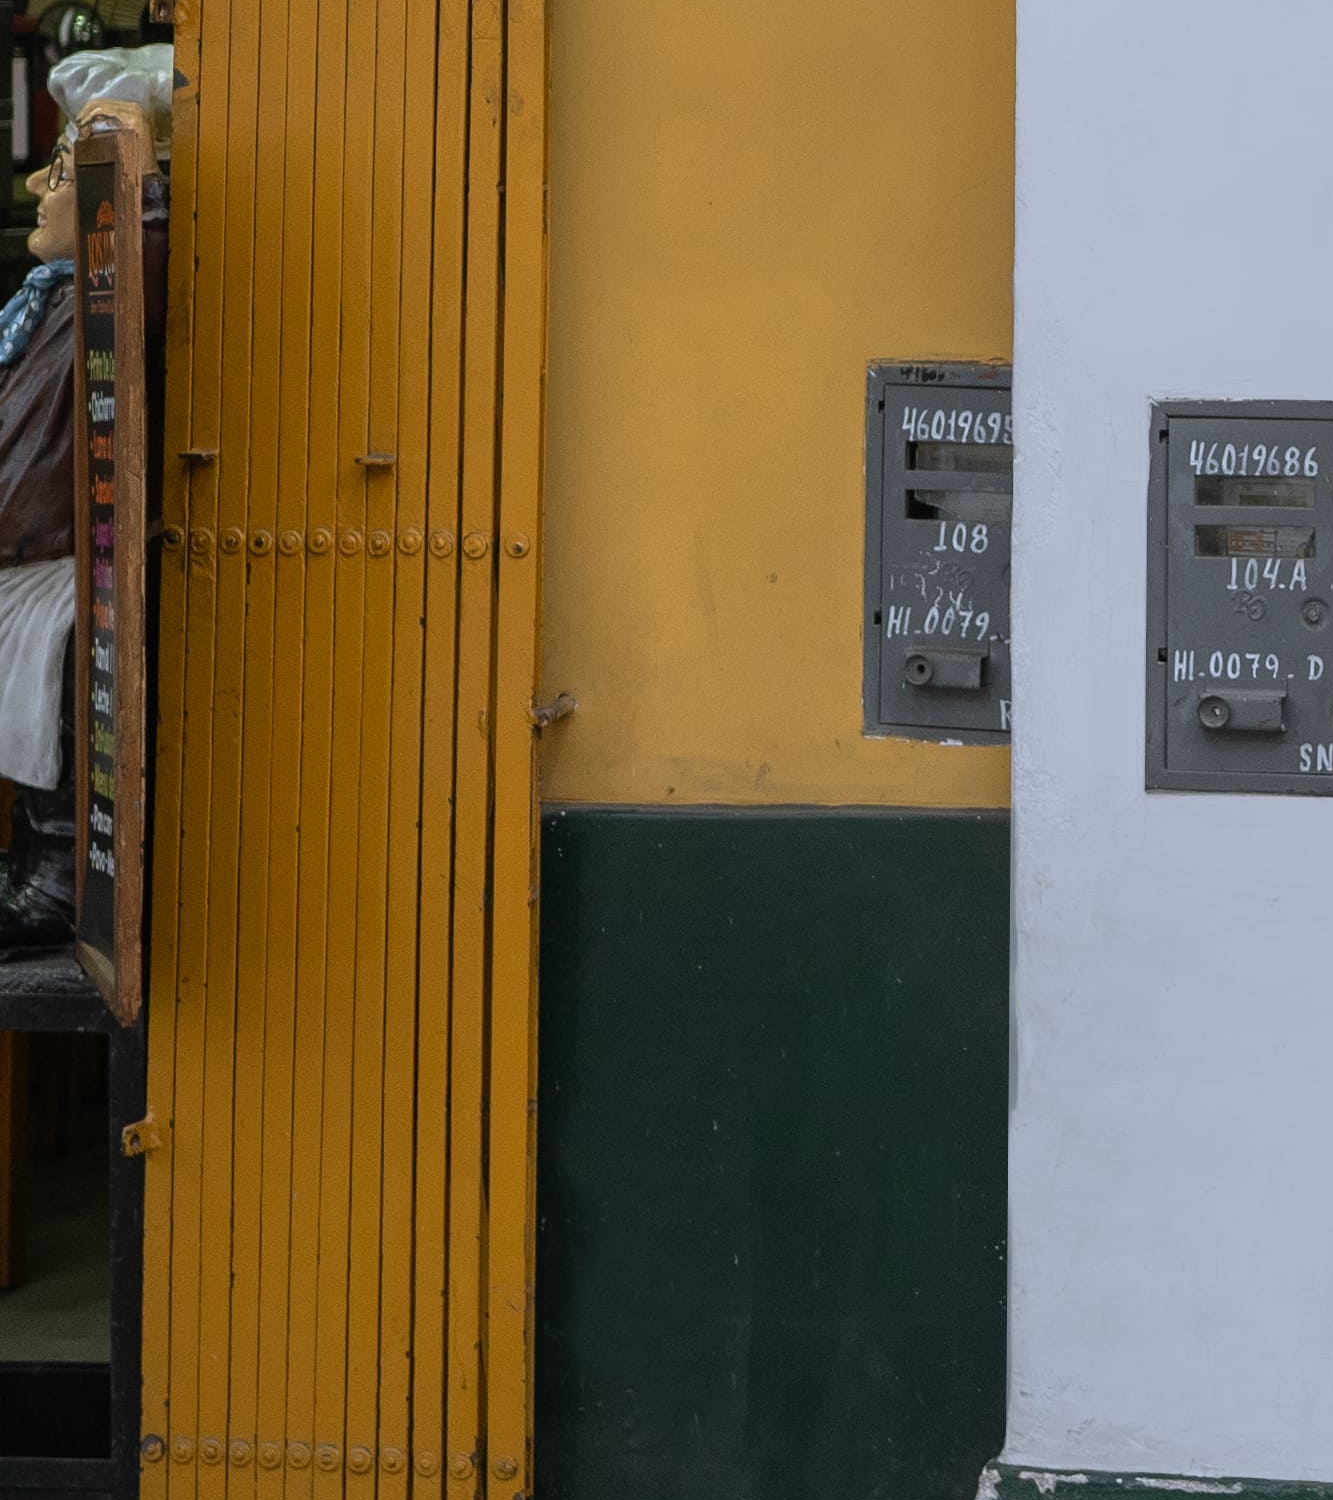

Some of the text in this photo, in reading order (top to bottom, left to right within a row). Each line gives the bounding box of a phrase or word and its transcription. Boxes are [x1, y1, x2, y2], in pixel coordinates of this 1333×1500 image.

[1190, 440, 1319, 477] 46019686
[934, 521, 989, 553] 108
[1300, 743, 1333, 772] SN
